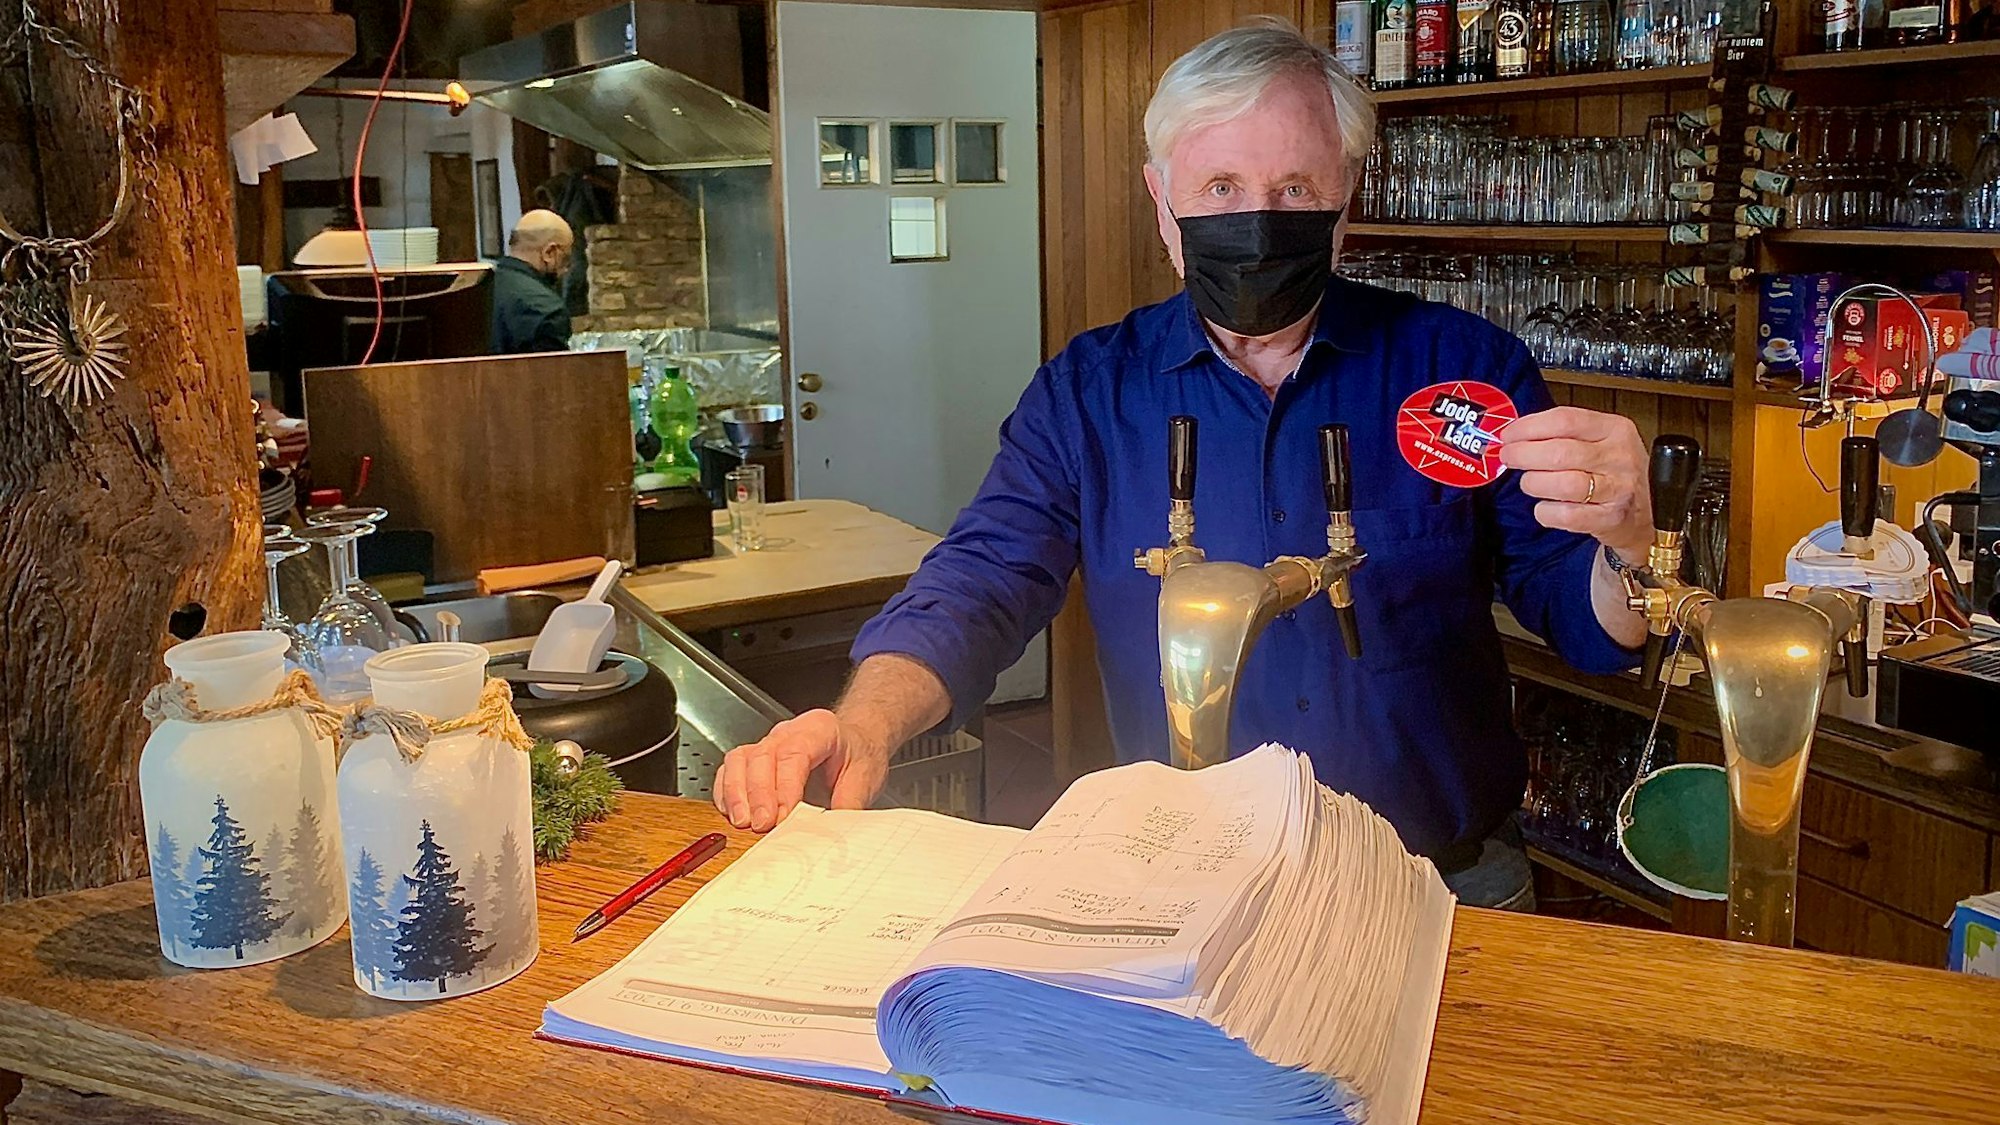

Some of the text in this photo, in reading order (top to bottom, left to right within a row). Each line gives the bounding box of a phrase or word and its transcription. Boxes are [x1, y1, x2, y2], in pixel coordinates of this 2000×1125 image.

[1499, 19, 1519, 36] 43
[1727, 48, 1745, 60] Bier
[1435, 398, 1478, 426] Jode
[1443, 424, 1482, 454] Lade
[1414, 440, 1476, 473] www.express.de
[700, 1002, 808, 1026] DONNERSTAG,
